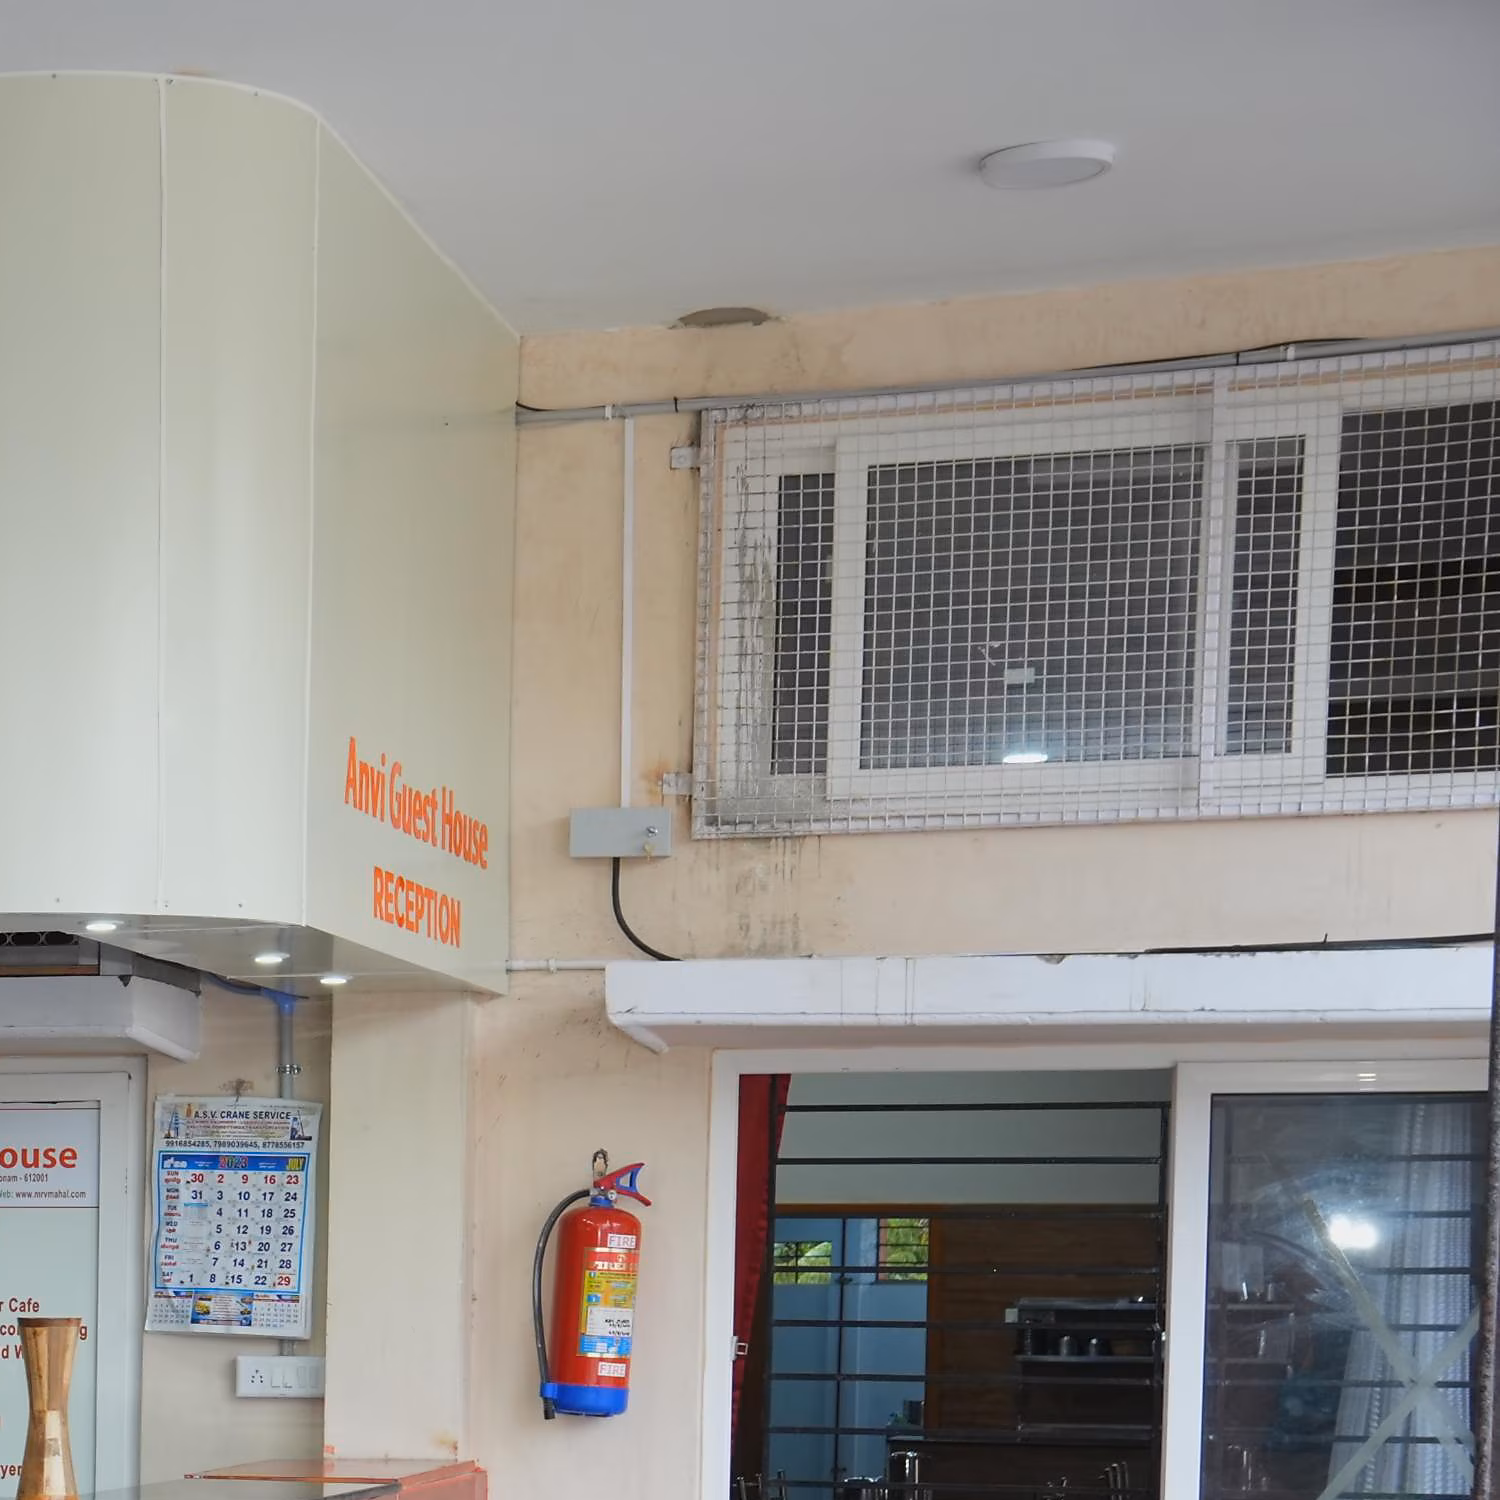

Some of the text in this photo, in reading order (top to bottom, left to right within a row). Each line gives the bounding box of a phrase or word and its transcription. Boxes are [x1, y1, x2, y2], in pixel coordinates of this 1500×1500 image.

[344, 736, 489, 870] Anvi Guest House
[373, 864, 461, 949] RECEPTION
[194, 1110, 291, 1119] A.S.V. CRANE SERVICE
[219, 1156, 249, 1168] 2023
[24, 1173, 48, 1183] 612001
[191, 1173, 204, 1183] 30
[218, 1174, 224, 1184] 2
[242, 1174, 249, 1184] 9
[264, 1175, 276, 1184] 16
[286, 1175, 300, 1185] 23
[16, 1190, 86, 1199] www.mrvmahal.com
[191, 1190, 203, 1200] 31
[217, 1191, 224, 1200] 3
[238, 1191, 250, 1200] 10
[262, 1192, 274, 1201] 17
[284, 1192, 298, 1201] 24
[216, 1208, 223, 1217] 4
[238, 1209, 249, 1218] 11
[261, 1209, 273, 1218] 18
[283, 1209, 296, 1218] 25
[216, 1225, 222, 1234] 5
[236, 1225, 248, 1234] 12
[259, 1226, 271, 1235] 19
[282, 1226, 294, 1235] 26
[214, 1241, 221, 1250] 6
[235, 1241, 247, 1251] 13
[258, 1242, 270, 1251] 20
[281, 1242, 293, 1252] 27
[609, 1236, 636, 1248] FIRE
[212, 1257, 219, 1266] 7
[233, 1258, 245, 1267] 14
[257, 1259, 268, 1268] 21
[279, 1259, 292, 1269] 28
[189, 1274, 193, 1282] 1
[209, 1274, 216, 1283] 8
[230, 1275, 242, 1284] 15
[254, 1275, 267, 1285] 22
[277, 1276, 291, 1286] 29
[9, 1298, 40, 1313] Cafe
